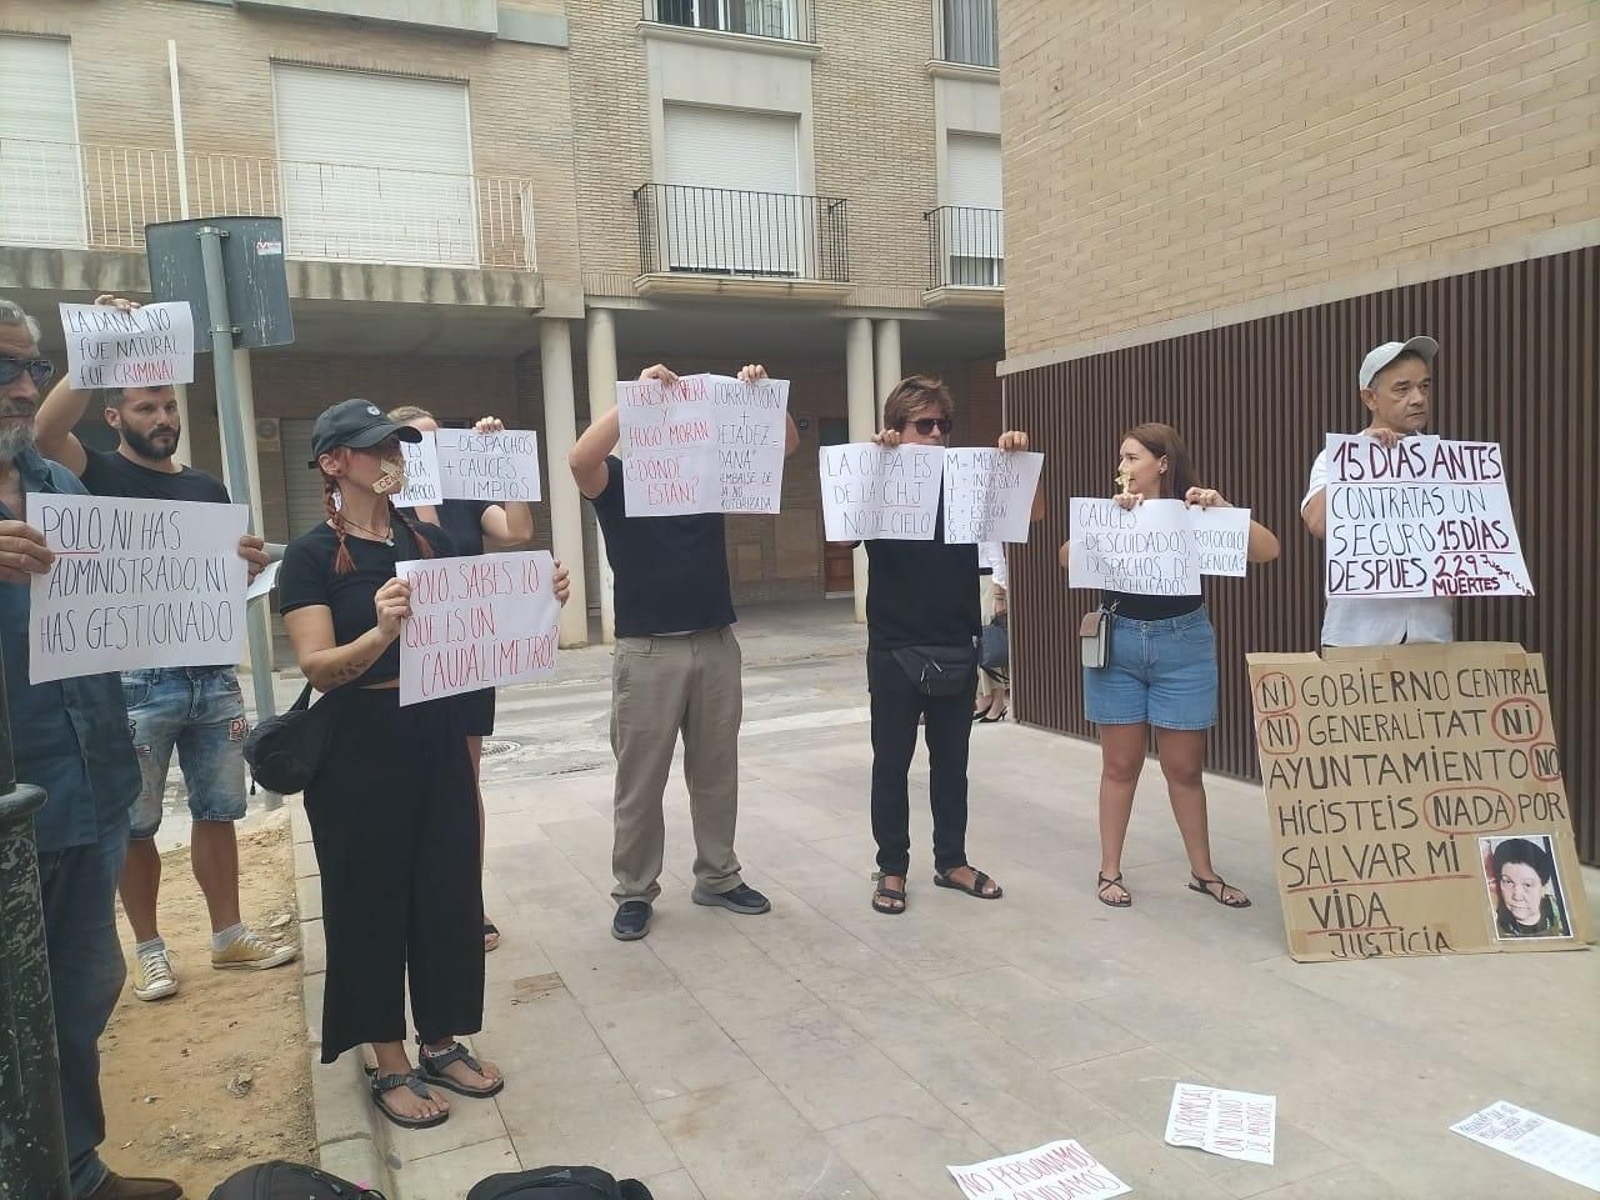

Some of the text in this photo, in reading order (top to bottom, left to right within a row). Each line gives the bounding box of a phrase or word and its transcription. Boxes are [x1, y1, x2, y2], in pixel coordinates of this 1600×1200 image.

[67, 309, 91, 333] LA
[145, 308, 171, 332] NO
[80, 337, 110, 360] FUE
[80, 364, 108, 387] FUE
[459, 434, 533, 455] DESPACHOS
[630, 425, 662, 448] HUGO
[459, 457, 517, 479] CAUCES
[827, 452, 852, 477] LA
[913, 452, 932, 478] ES
[1332, 441, 1365, 481] 15
[1431, 442, 1501, 482] ANTES
[461, 477, 530, 500] LIMPIOS
[835, 484, 858, 504] DE
[883, 480, 925, 505] CHJ
[1331, 486, 1486, 520] CONTRATAS UN
[110, 508, 133, 551] NI
[142, 511, 181, 550] HAS
[844, 510, 866, 535] NO
[891, 511, 931, 534] CIELO
[1080, 502, 1137, 529] CAUCES
[1332, 523, 1436, 557] SEGURO
[1437, 519, 1461, 551] 15
[205, 557, 228, 592] NI
[458, 560, 513, 599] SABES
[521, 559, 540, 595] LO
[1174, 557, 1190, 580] DE
[1328, 557, 1427, 593] DESPUES
[1434, 554, 1478, 578] 229
[1432, 577, 1501, 596] MUERTES
[40, 601, 233, 654] HAS GESTIONADO
[405, 602, 496, 648] QUE ES UN
[1261, 666, 1547, 709] NI GOBIERNO CENTRAL
[1266, 705, 1534, 747] NI GENERALITAT NI
[1269, 745, 1560, 791] AYUNTAMIENTO NO
[1278, 792, 1566, 837] HICISTEIS NADA POR
[1281, 834, 1460, 888] SALVAR MI
[1309, 888, 1392, 929] VIDA
[1328, 926, 1455, 957] JUSTICIA
[957, 1173, 995, 1198] NO
